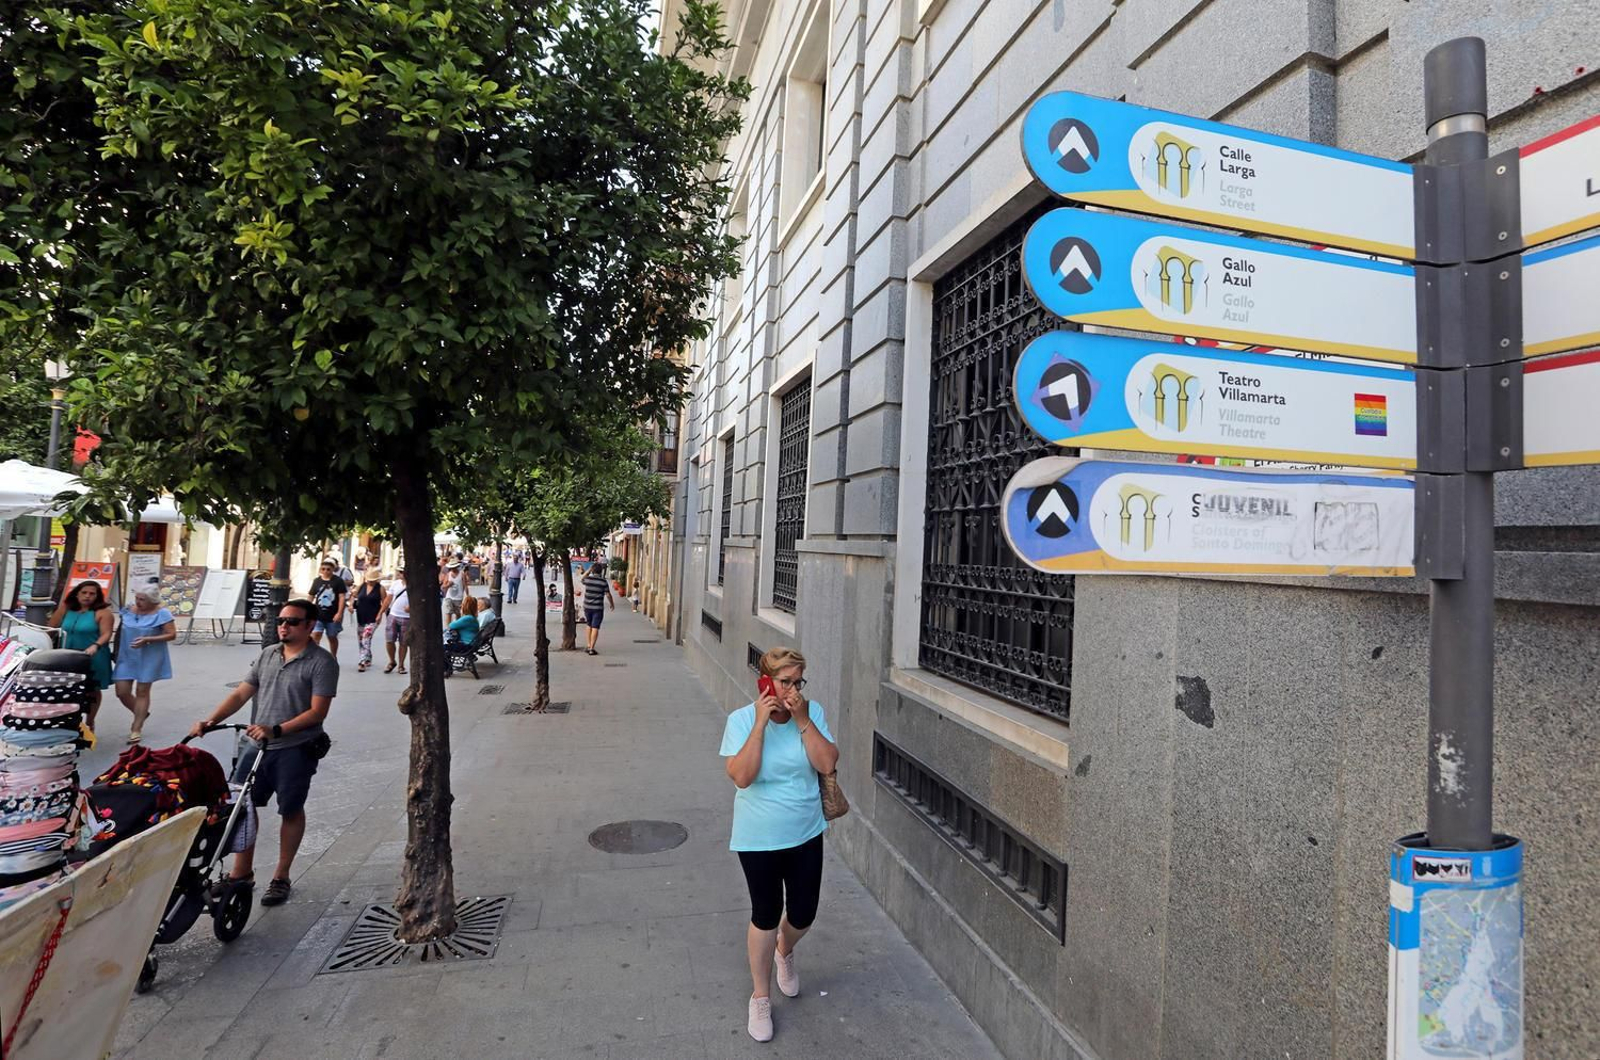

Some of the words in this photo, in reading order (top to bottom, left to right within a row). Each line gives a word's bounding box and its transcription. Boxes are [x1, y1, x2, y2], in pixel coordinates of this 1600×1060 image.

[1220, 145, 1252, 162] Calle
[1220, 159, 1256, 179] Larga
[1220, 180, 1253, 199] Larga
[1586, 178, 1600, 197] L
[1220, 194, 1255, 211] Street
[1222, 257, 1255, 273] Gallo
[1222, 272, 1252, 288] Azul
[1222, 293, 1254, 308] Gallo
[1222, 308, 1249, 323] Azul
[1219, 371, 1261, 388] Teatro
[1219, 386, 1286, 405] Villamarta
[1218, 408, 1280, 426] Villamarta
[1220, 423, 1266, 440] Theatre
[1204, 494, 1293, 516] JUVENIL
